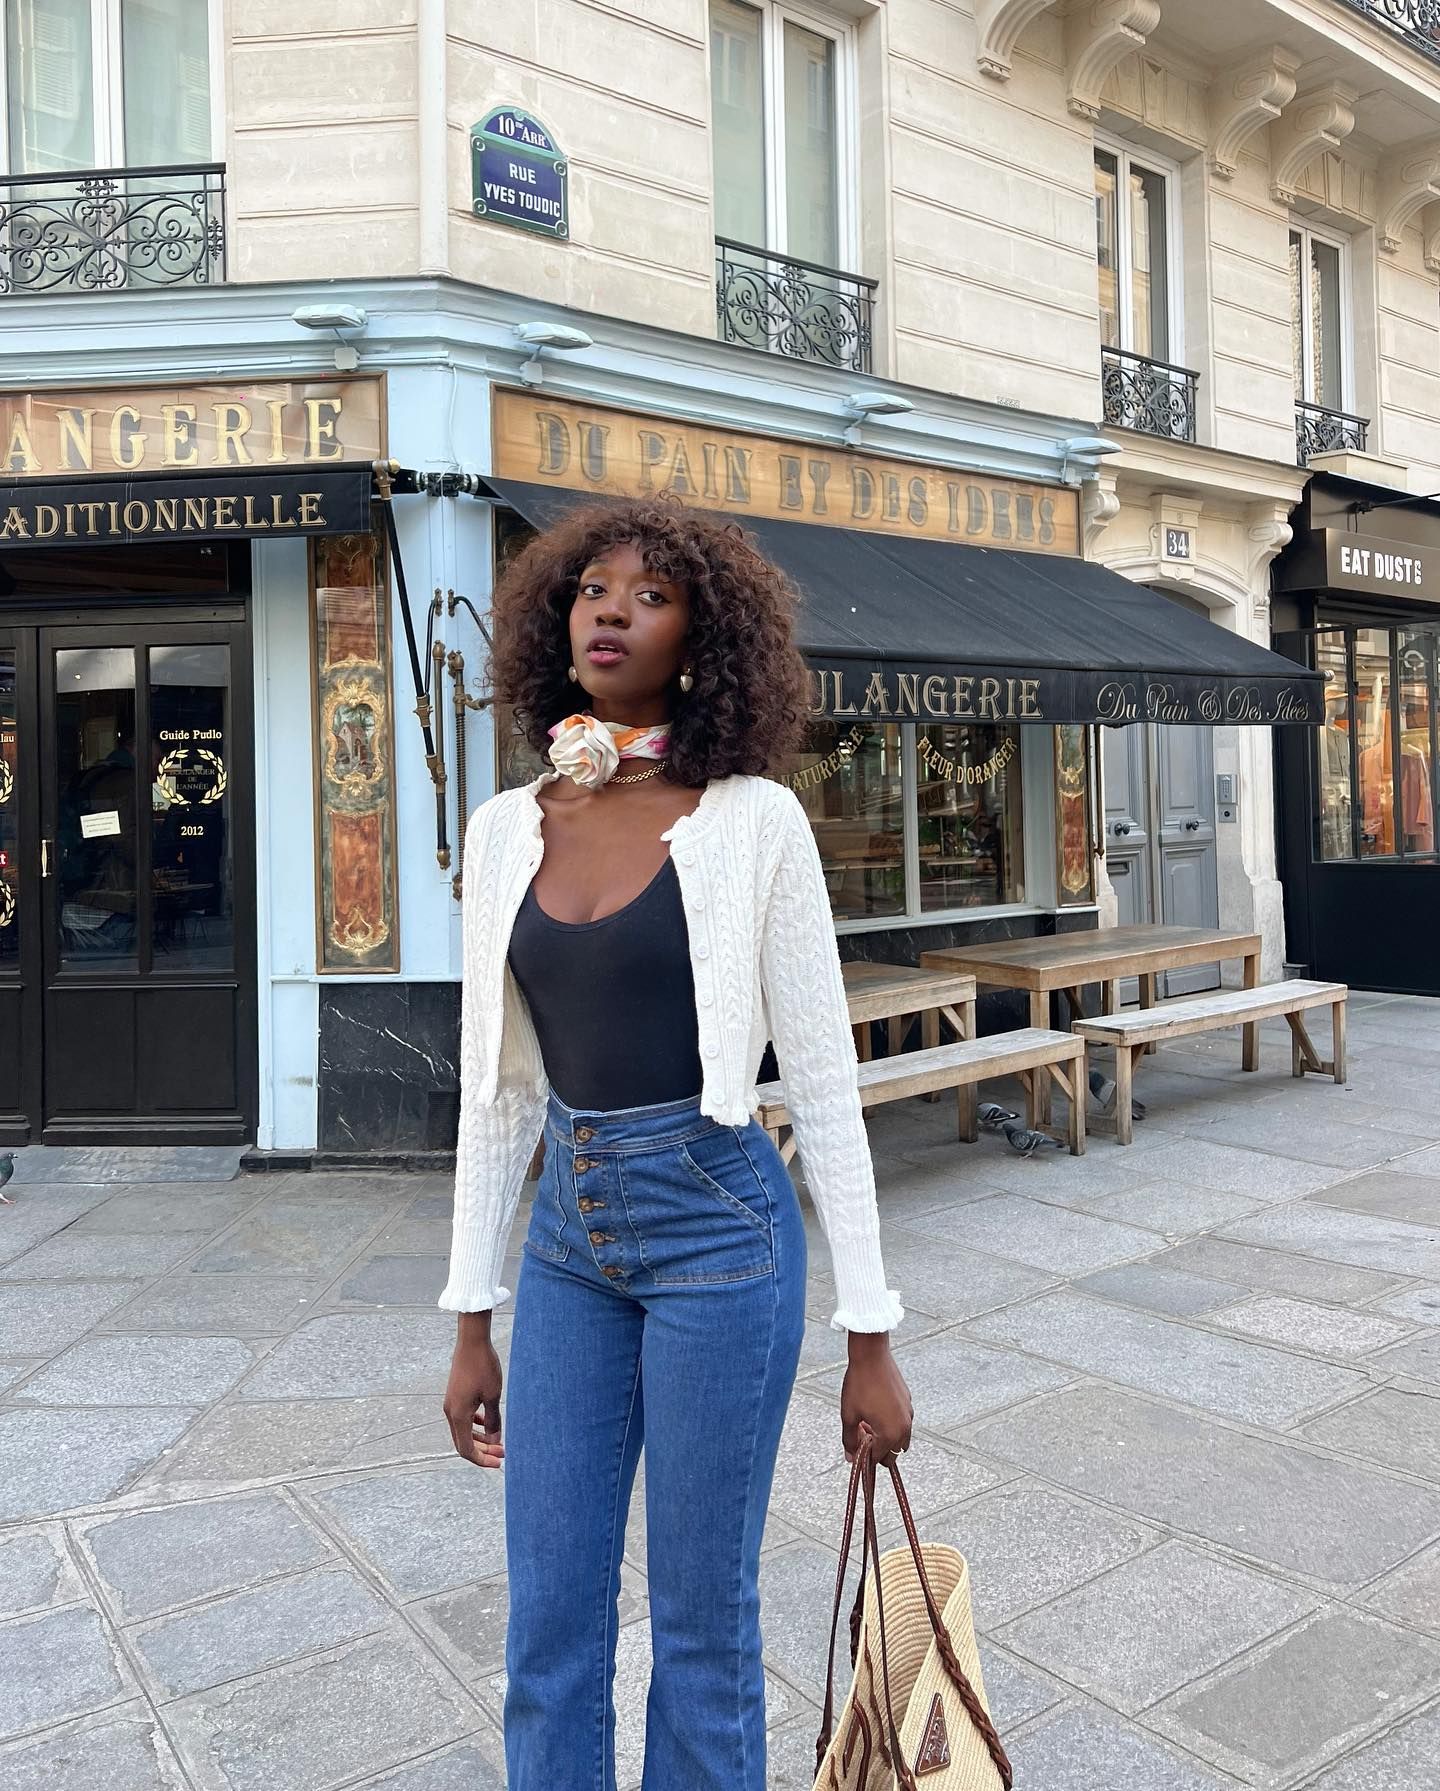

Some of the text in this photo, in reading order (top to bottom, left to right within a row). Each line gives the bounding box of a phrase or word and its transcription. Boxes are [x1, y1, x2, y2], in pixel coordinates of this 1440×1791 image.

[509, 163, 537, 184] RUE
[484, 182, 561, 217] YVES TOUDIC
[0, 398, 345, 472] ANGERIE
[536, 412, 610, 482] DU
[637, 430, 753, 503] PAIN
[851, 466, 928, 527] DES
[0, 492, 328, 540] ADITIONNELLE
[1169, 531, 1187, 556] 34
[1341, 546, 1371, 577] EAT
[1374, 552, 1413, 584] DUST
[1096, 682, 1310, 721] Du Pain & Des Idées
[160, 729, 222, 740] Guide Pudlo
[916, 735, 953, 781] FLEUR
[181, 826, 204, 836] 2012
